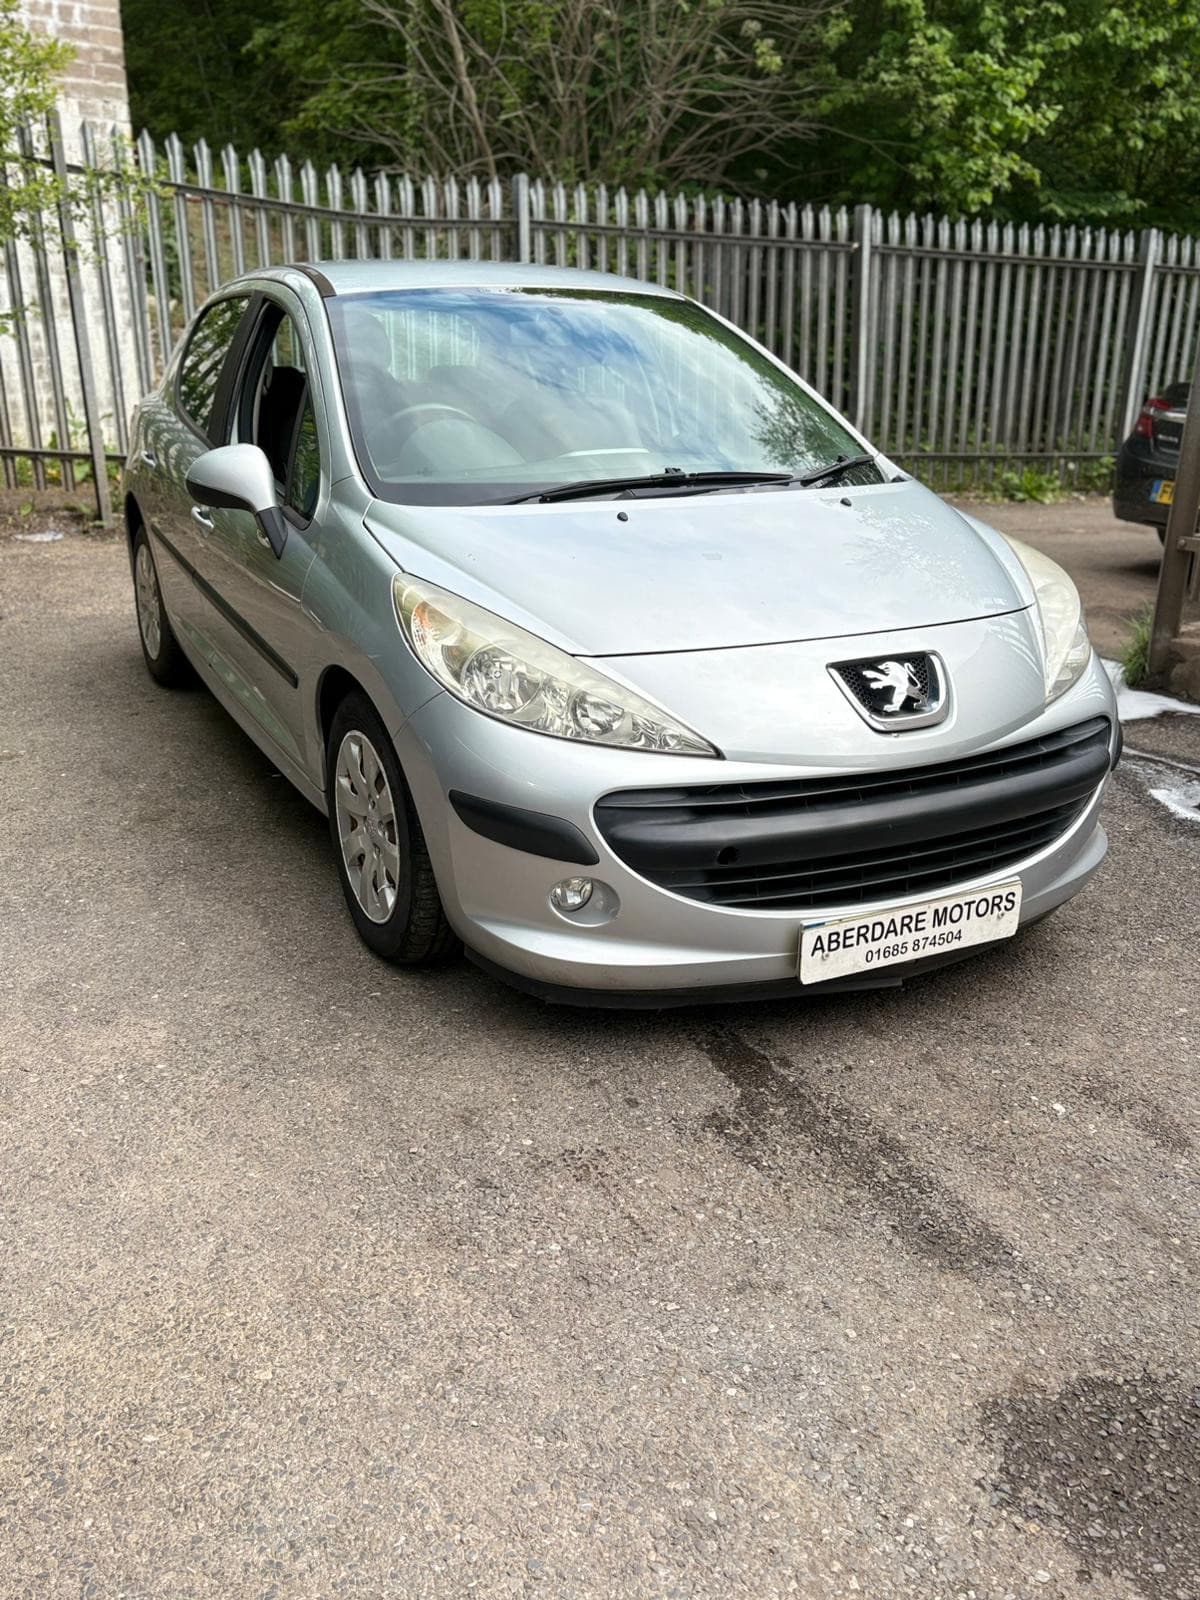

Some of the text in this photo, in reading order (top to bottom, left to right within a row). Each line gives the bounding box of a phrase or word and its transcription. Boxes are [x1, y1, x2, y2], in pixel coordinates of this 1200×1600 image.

[811, 892, 1016, 957] ABERDARE MOTORS
[865, 929, 962, 963] 01685 874504
